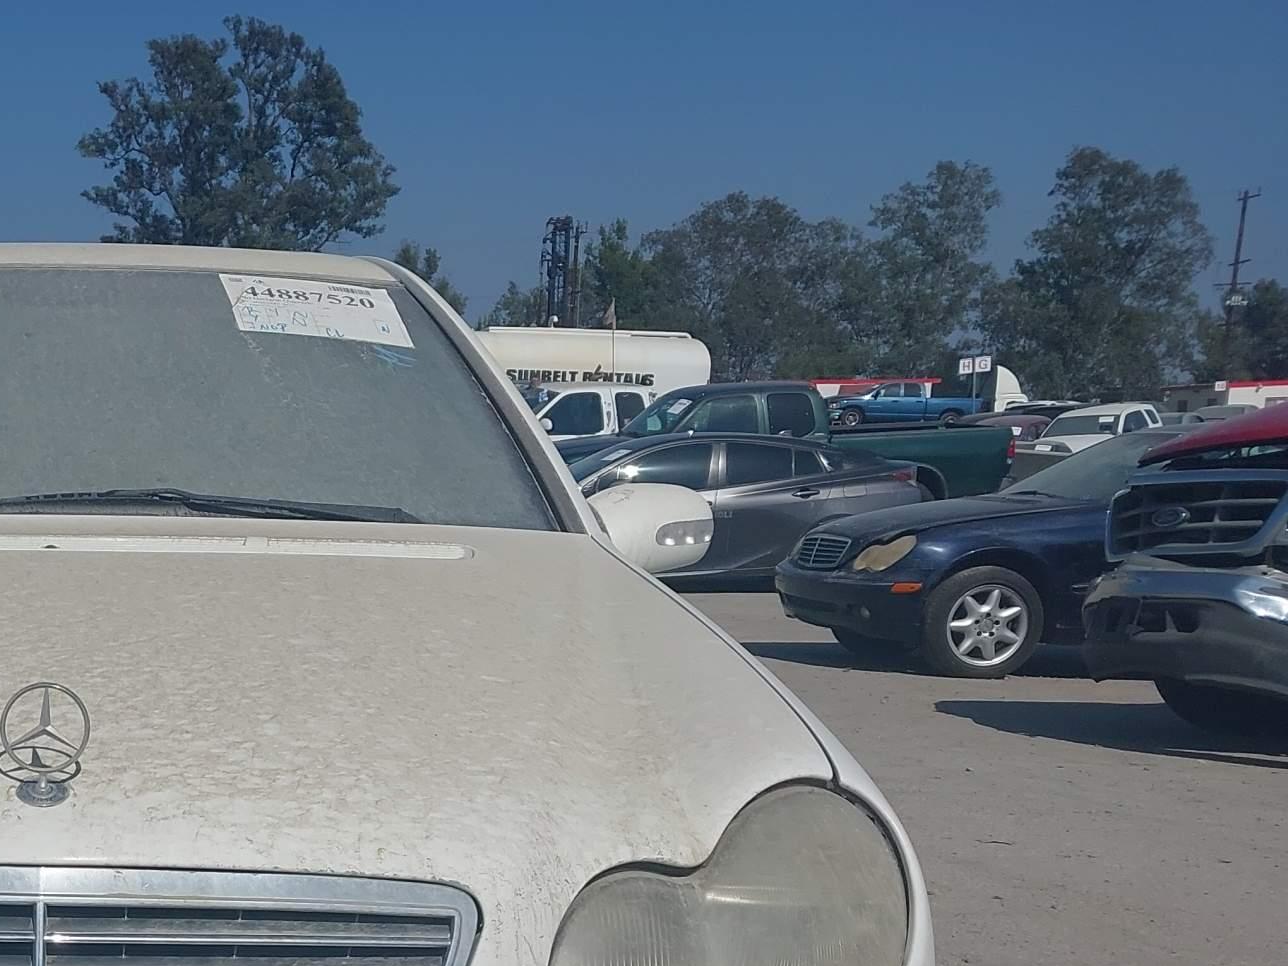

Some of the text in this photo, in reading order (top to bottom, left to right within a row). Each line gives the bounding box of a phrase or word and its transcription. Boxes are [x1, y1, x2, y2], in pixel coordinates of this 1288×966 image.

[245, 286, 374, 309] 44887520
[962, 360, 971, 372] H
[978, 359, 988, 370] G
[506, 368, 578, 383] SUNBELT
